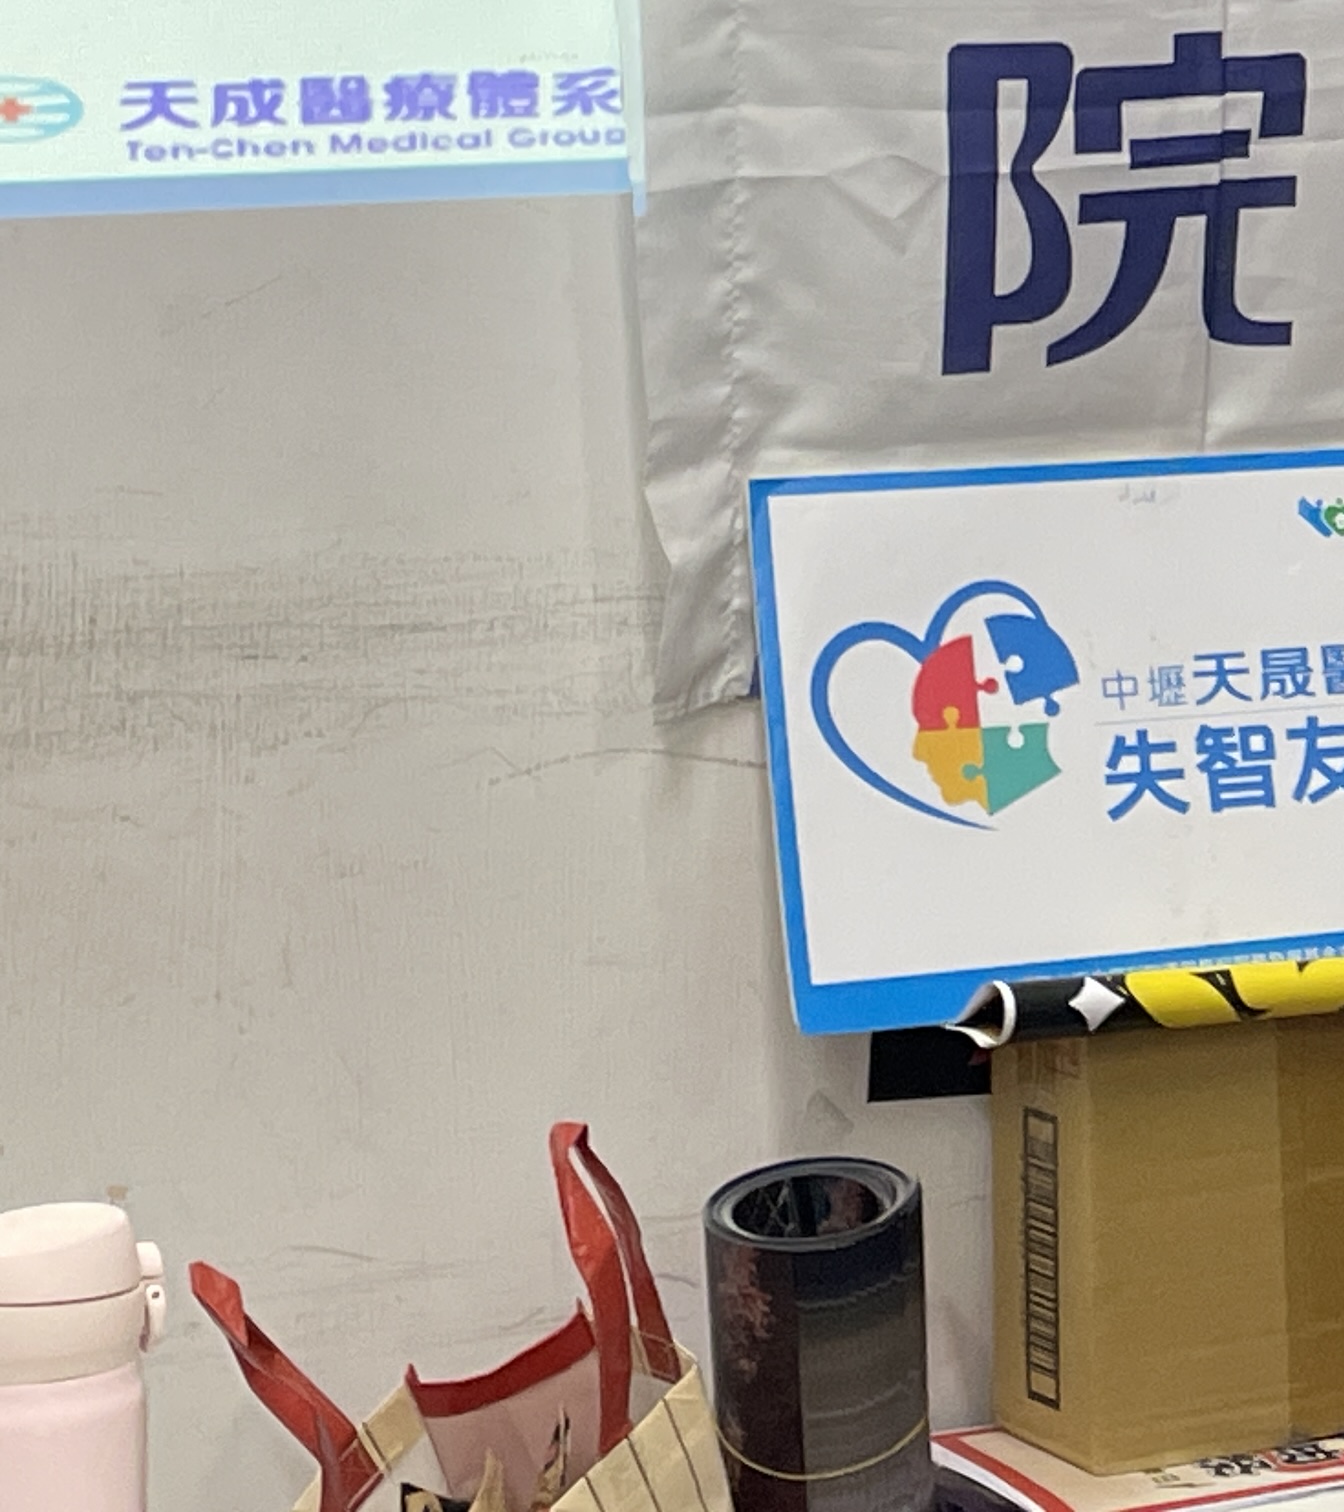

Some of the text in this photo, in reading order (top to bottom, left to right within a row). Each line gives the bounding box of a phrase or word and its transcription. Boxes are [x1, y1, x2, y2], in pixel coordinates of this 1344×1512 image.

[120, 66, 624, 131] 天成醫療體系
[126, 137, 316, 163] Ten-Chen
[329, 129, 494, 155] Medical
